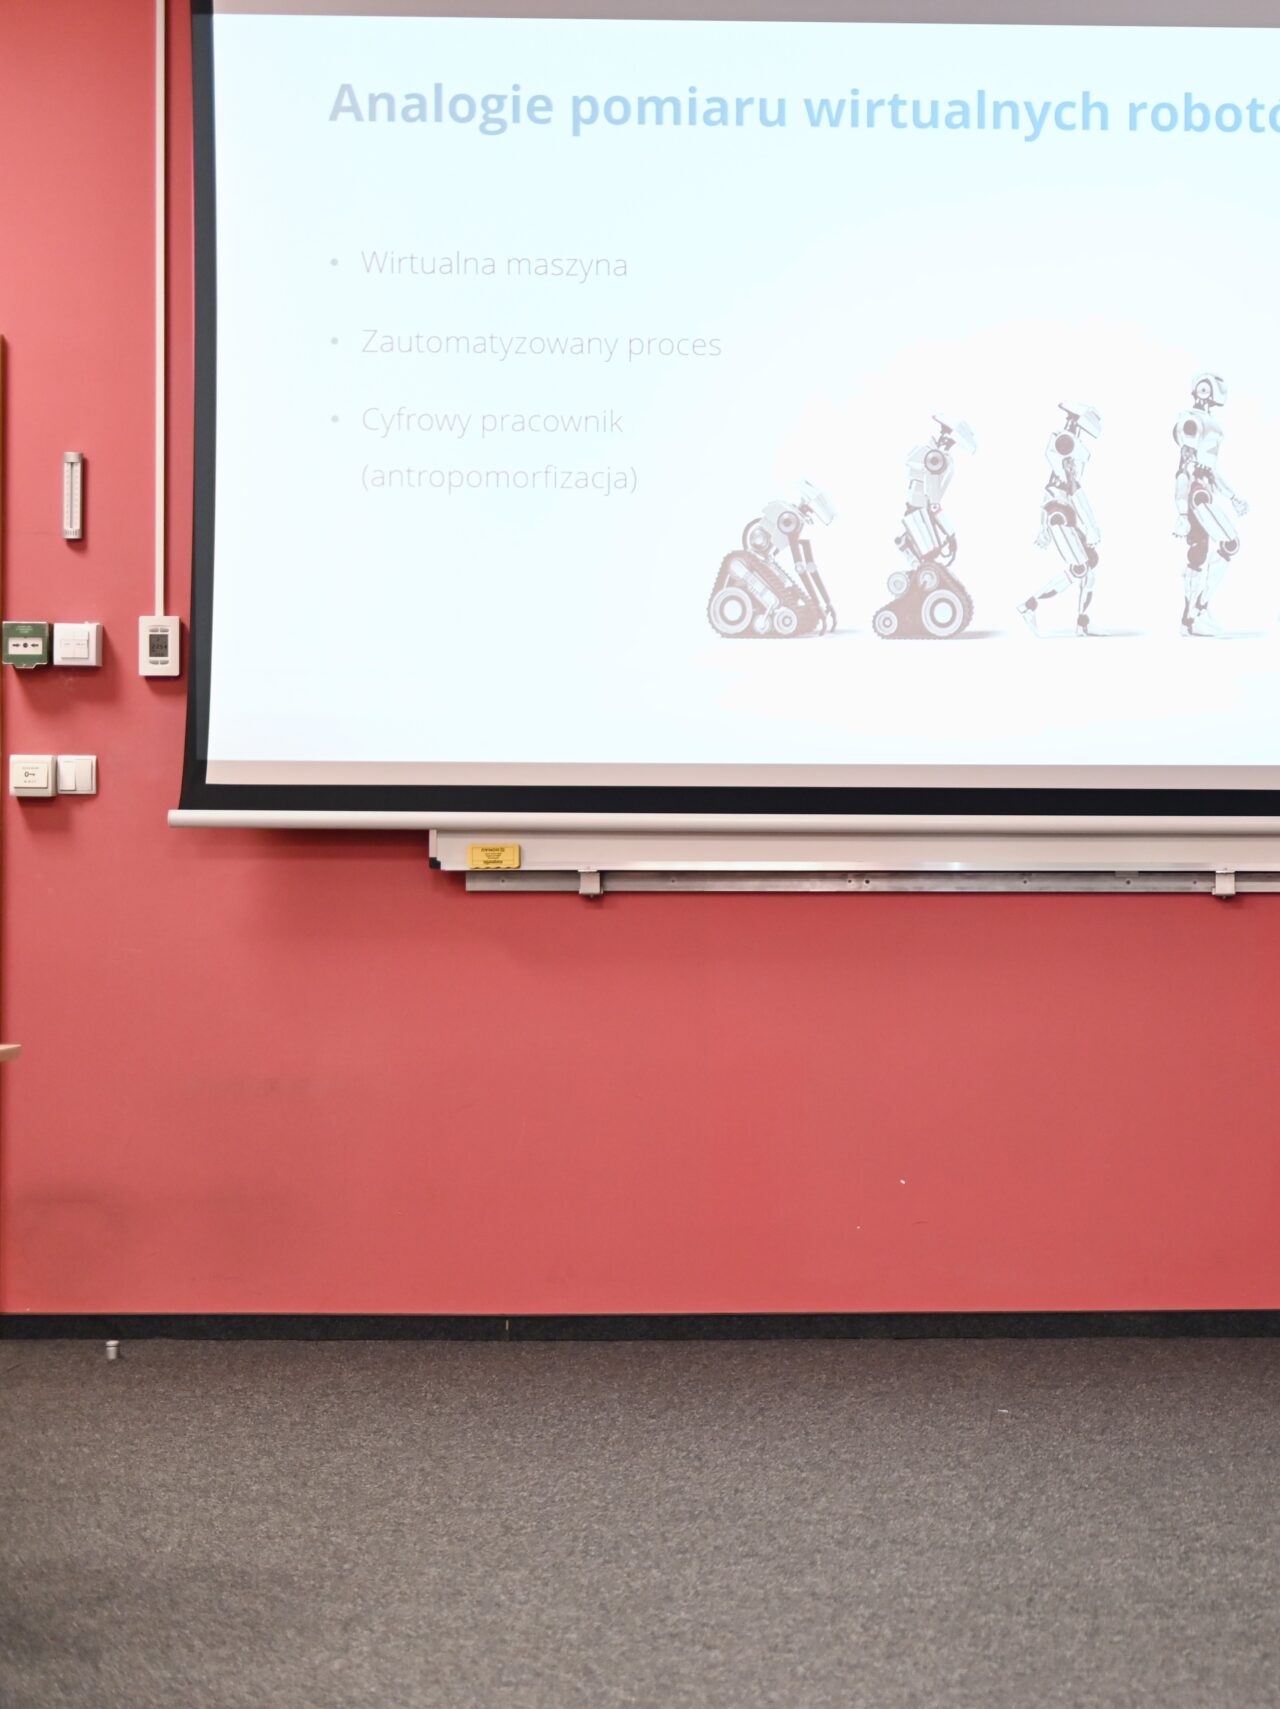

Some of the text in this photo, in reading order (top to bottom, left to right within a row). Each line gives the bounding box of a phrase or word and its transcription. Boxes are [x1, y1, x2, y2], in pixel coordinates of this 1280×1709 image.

[328, 82, 555, 136] Analogie
[571, 85, 788, 137] pomiaru
[803, 87, 1109, 143] wirtualnych
[360, 250, 629, 286] Wirtualna maszyna
[361, 328, 722, 363] Zautomatyzowany proces
[361, 405, 624, 440] Cyfrowy pracownik
[360, 463, 638, 497] (antropomorfizacja)
